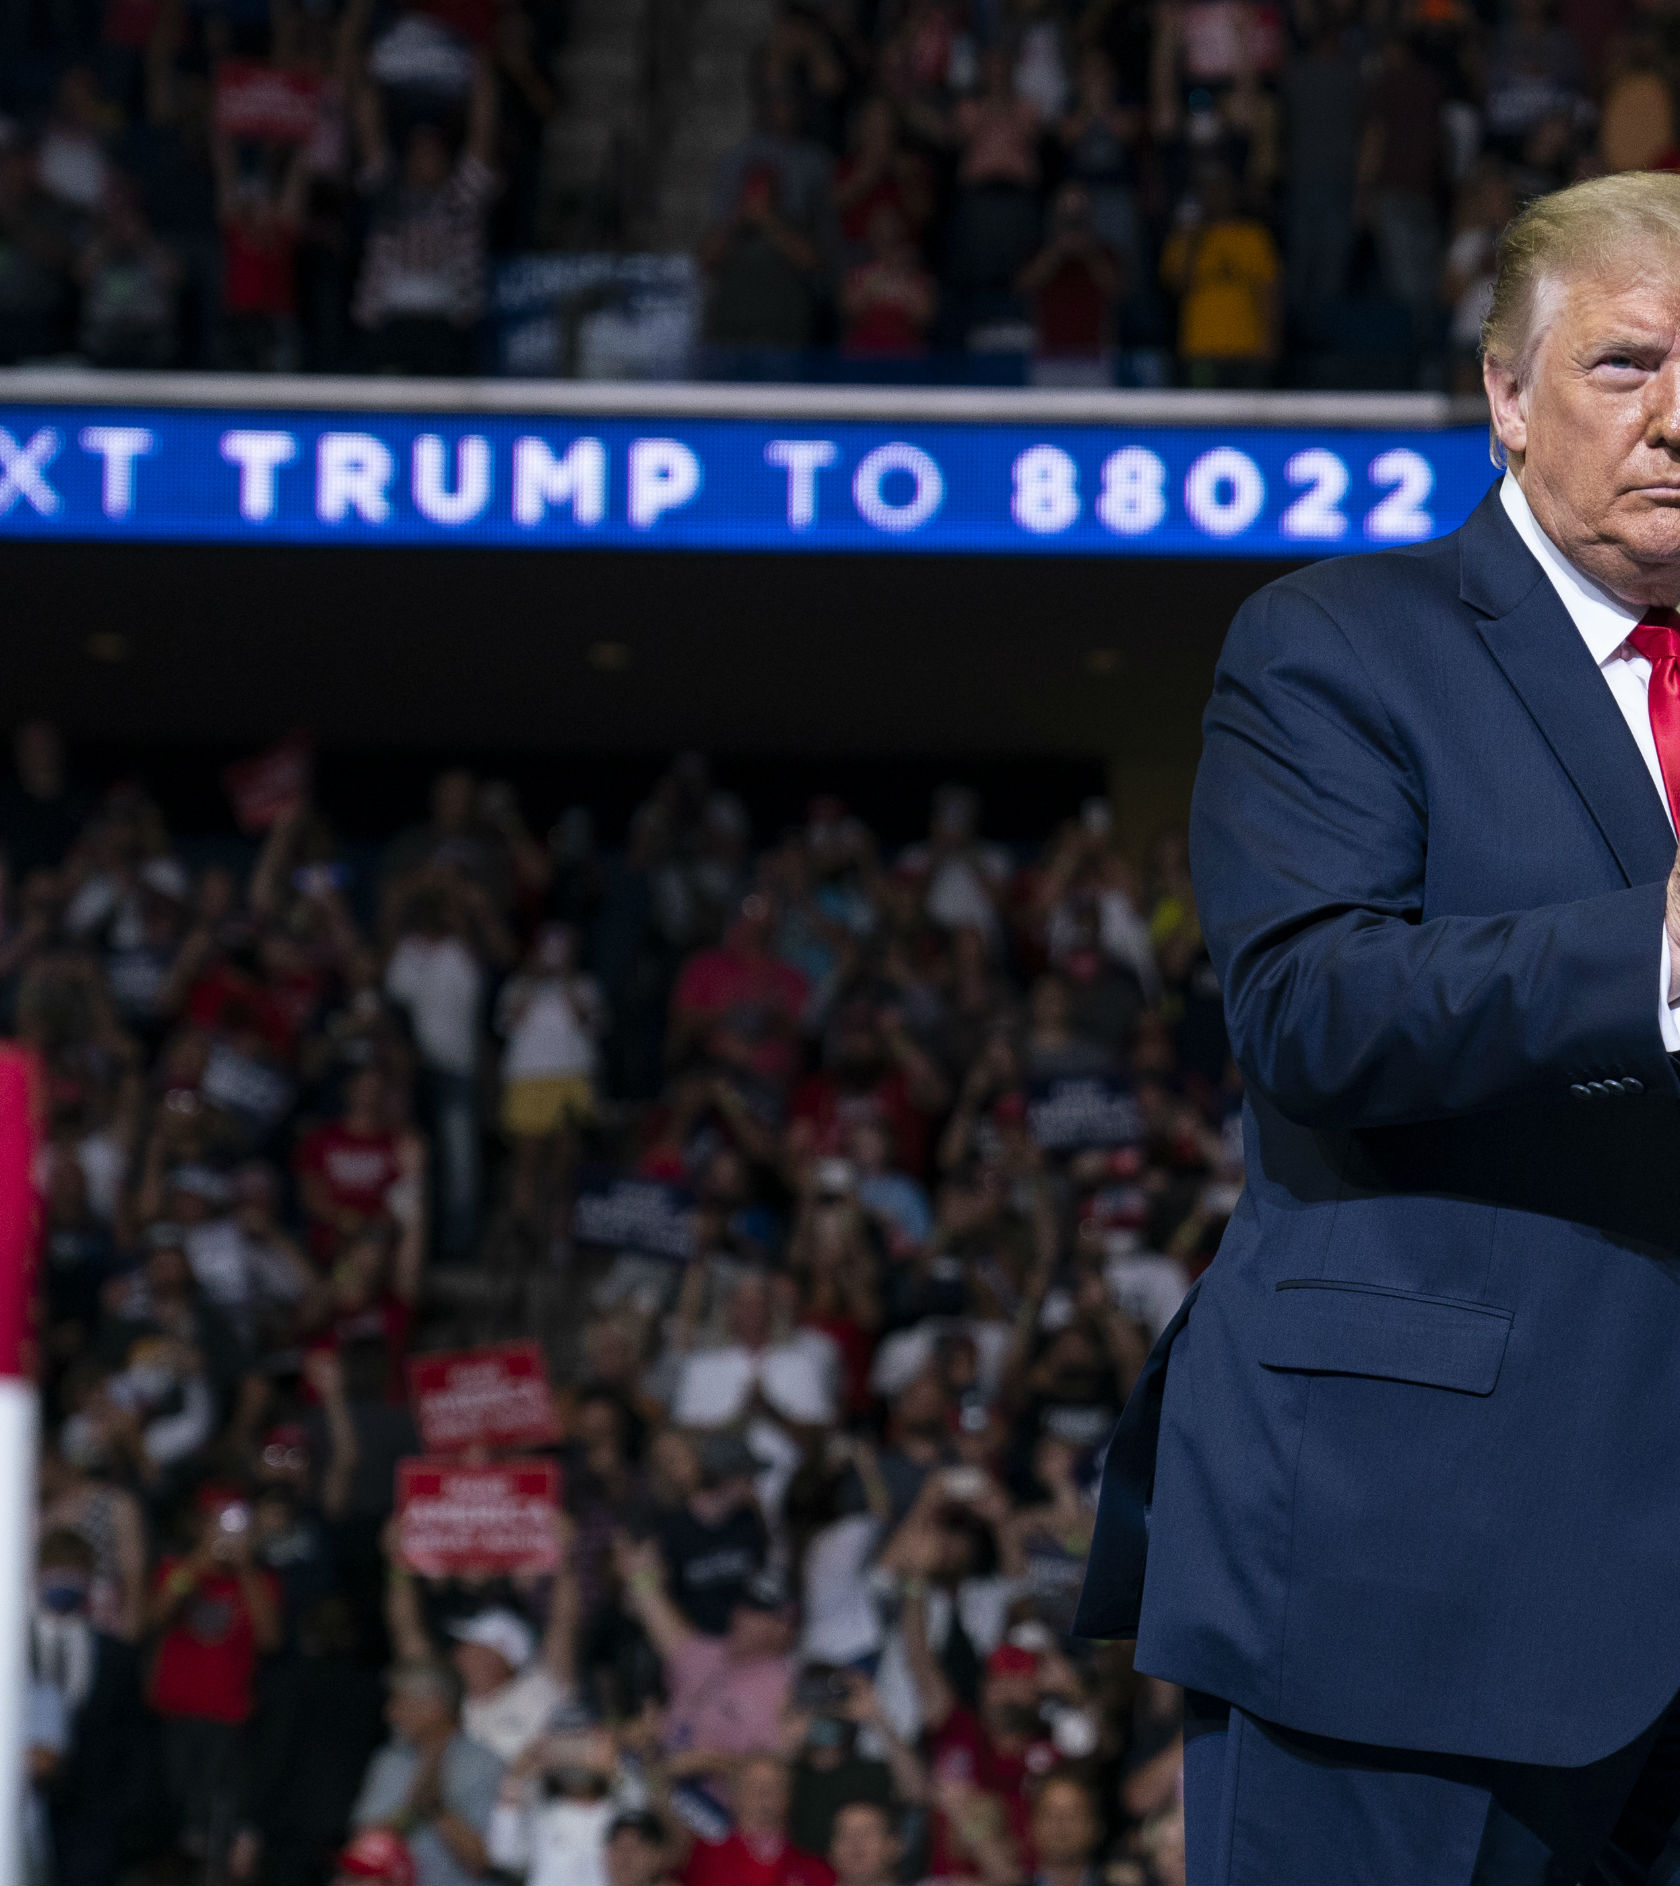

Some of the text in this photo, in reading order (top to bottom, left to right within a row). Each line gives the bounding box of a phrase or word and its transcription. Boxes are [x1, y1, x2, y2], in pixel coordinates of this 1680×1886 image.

[0, 426, 1434, 541] XT TRUMP TO 88022
